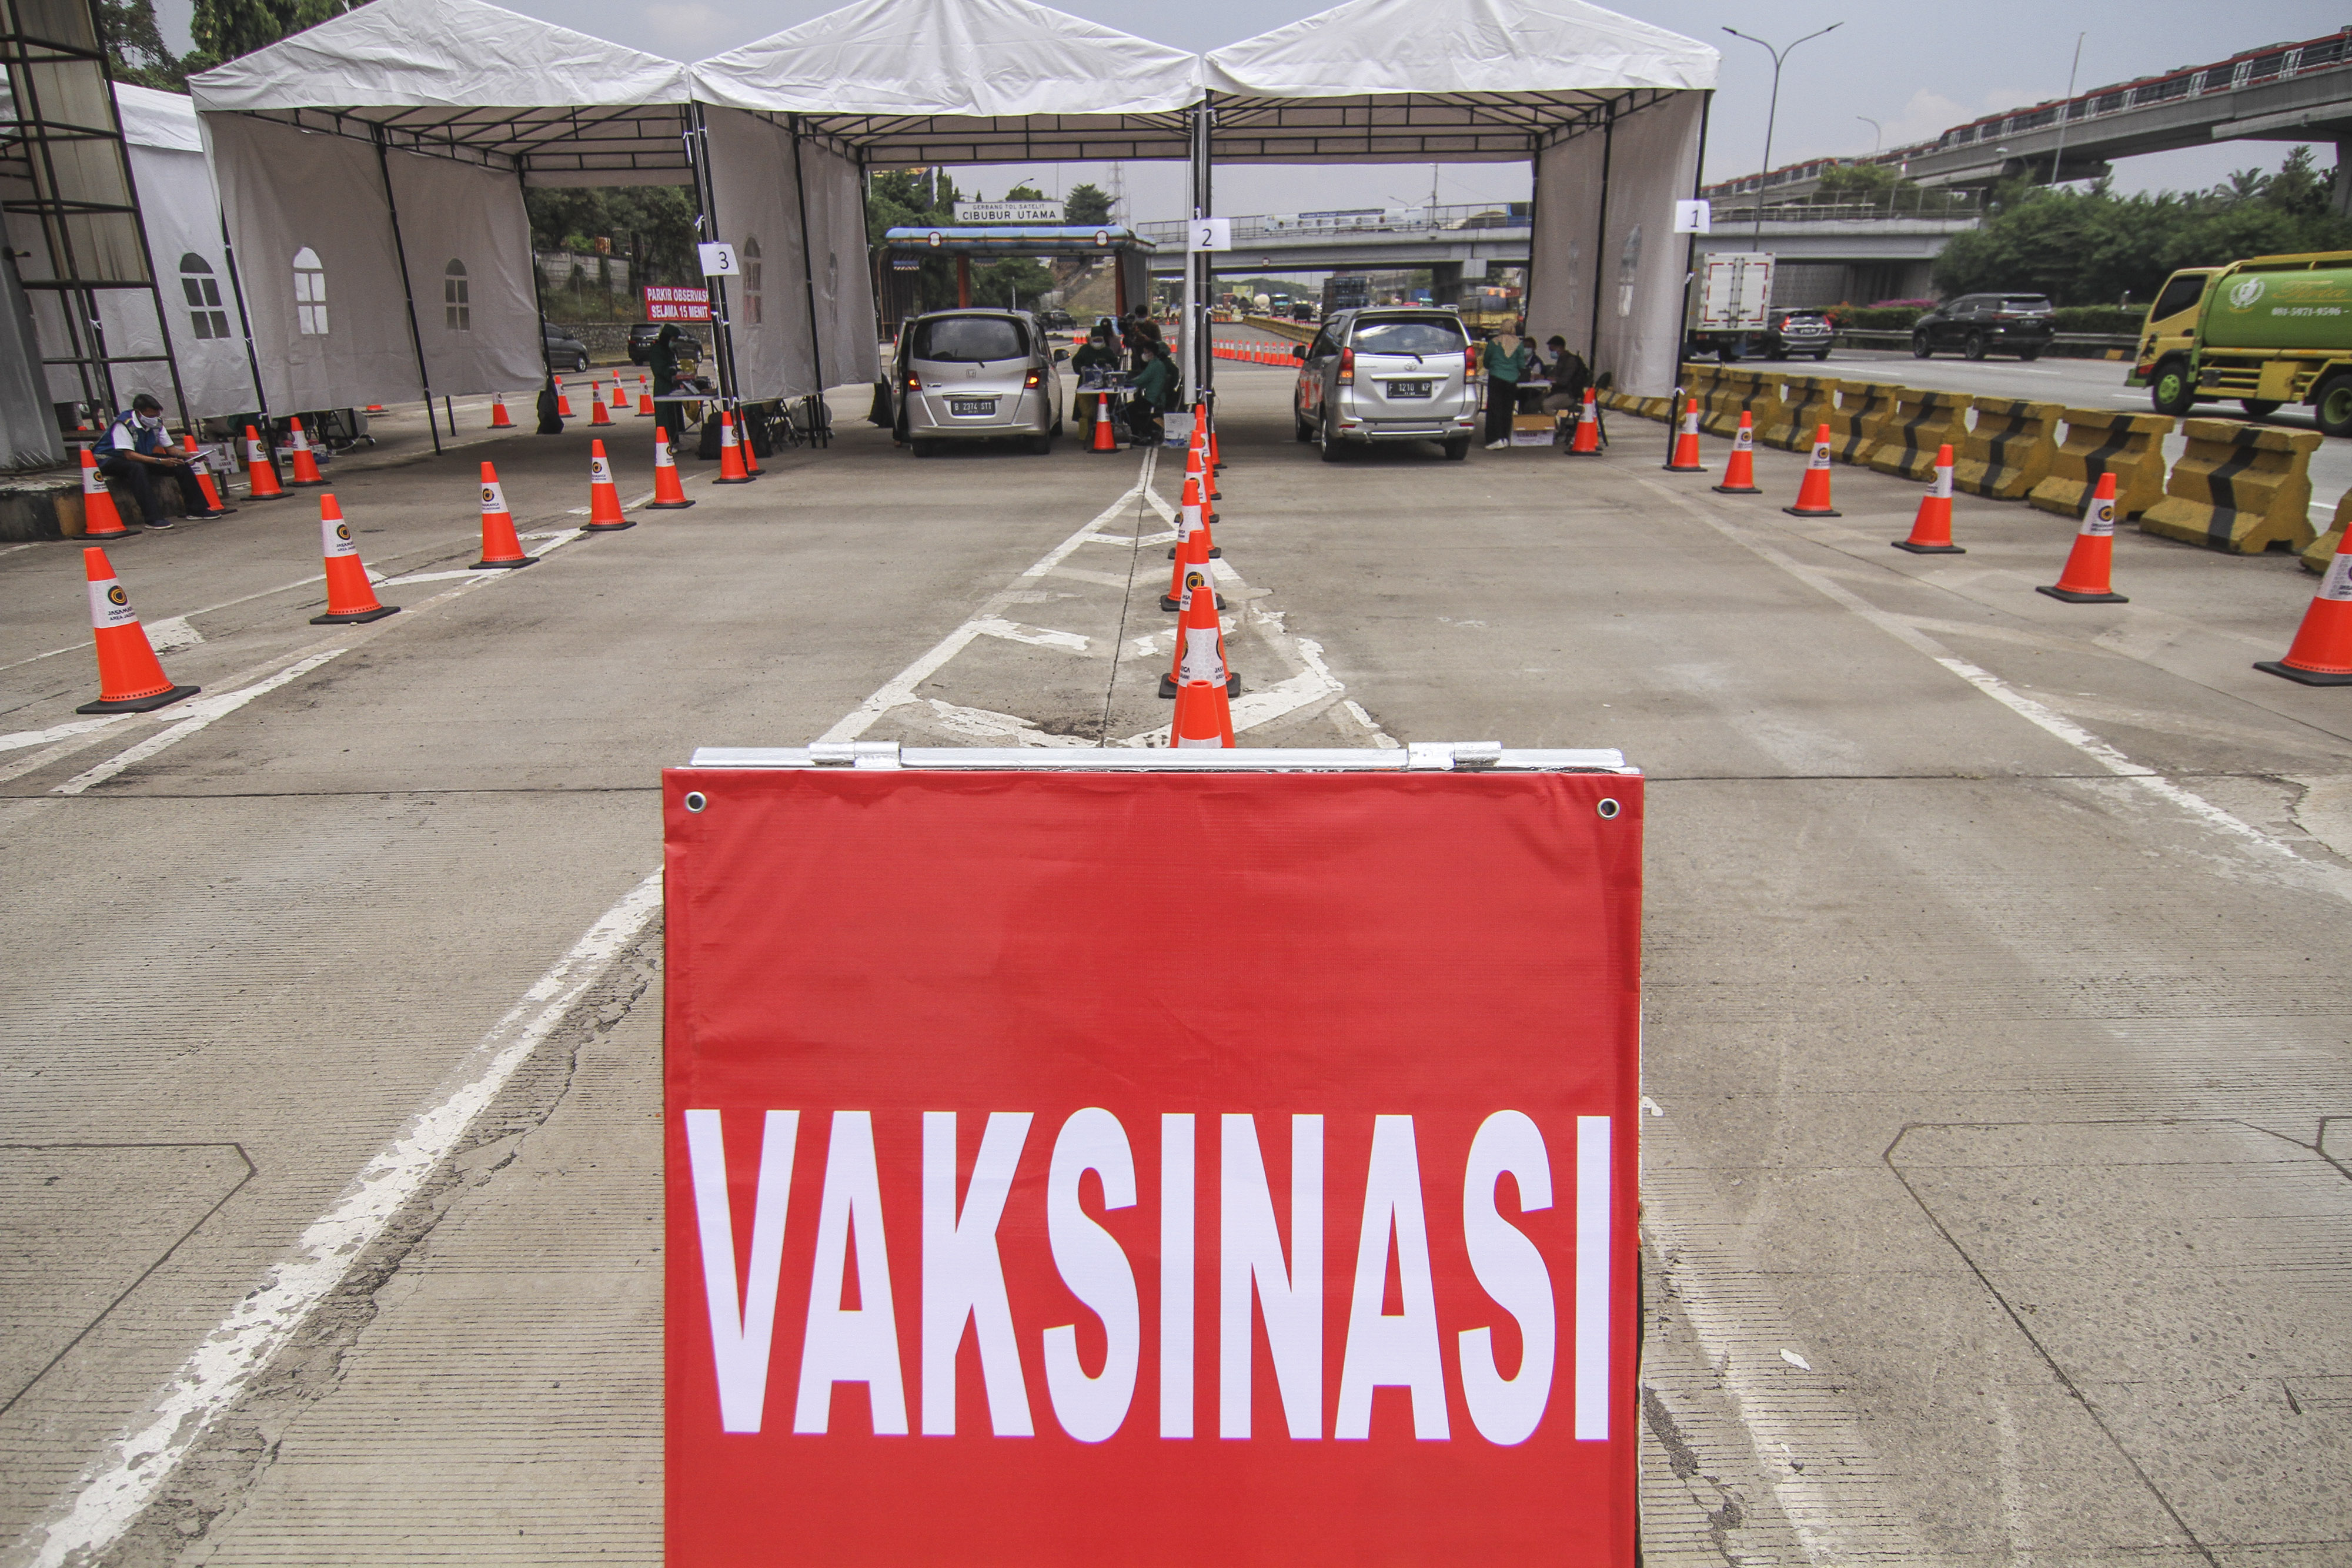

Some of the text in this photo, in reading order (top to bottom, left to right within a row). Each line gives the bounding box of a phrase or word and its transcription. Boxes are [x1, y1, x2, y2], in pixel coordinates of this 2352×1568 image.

[963, 210, 1057, 220] CIBUBUR UTAMA
[1690, 209, 1699, 228] 1
[1202, 228, 1212, 246] 2
[719, 251, 729, 269] 3
[647, 288, 672, 302] PARKIR
[652, 305, 708, 318] SELAMA 15 MENIT
[1399, 383, 1415, 392] 1210
[963, 402, 978, 410] 2374
[684, 1106, 1611, 1446] VAKSINASI
